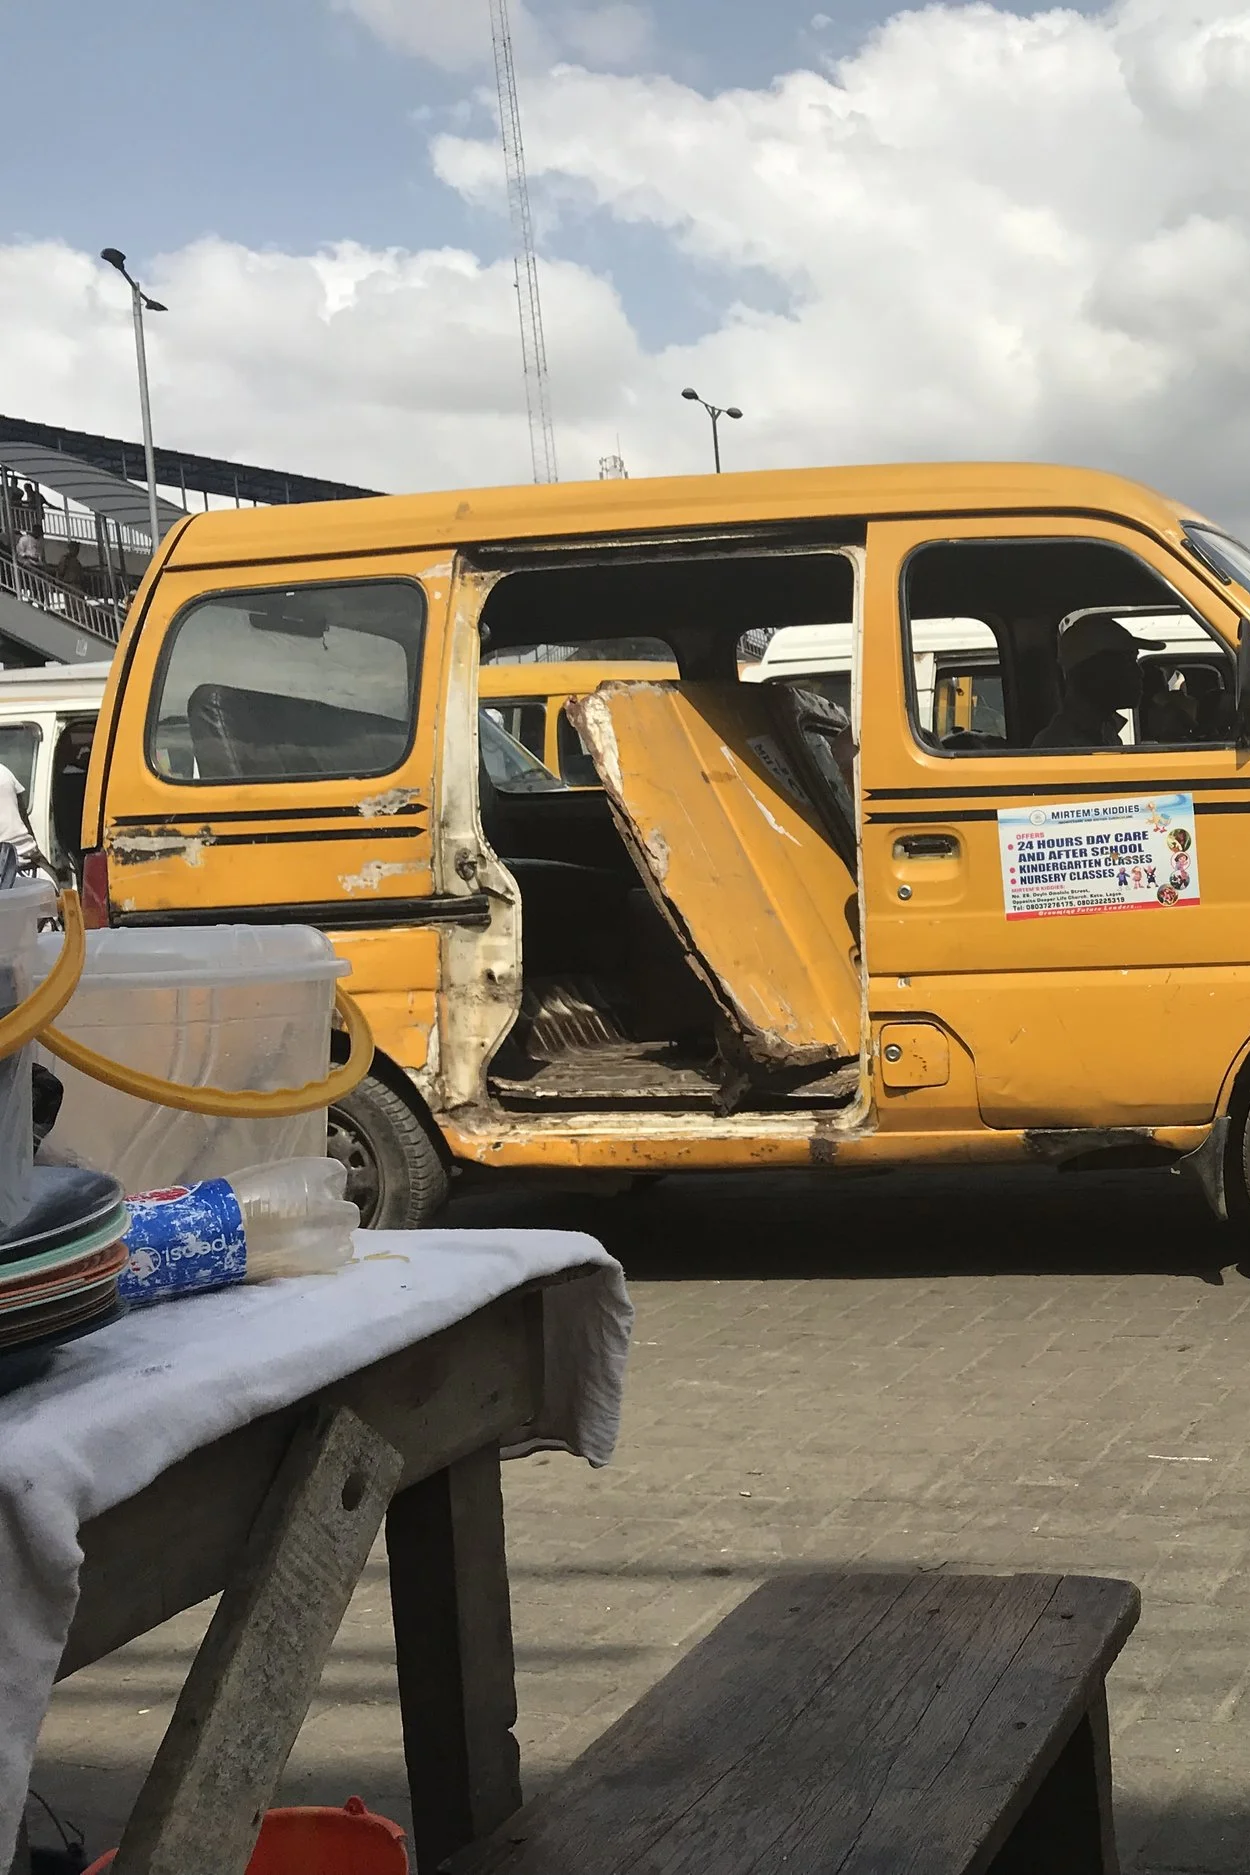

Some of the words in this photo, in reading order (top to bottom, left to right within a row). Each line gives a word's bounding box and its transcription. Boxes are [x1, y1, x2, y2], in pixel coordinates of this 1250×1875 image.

[1051, 807, 1100, 820] MIRTEM'S
[1103, 804, 1140, 816] KIDDIES
[1016, 832, 1045, 840] OFFERS
[1017, 840, 1034, 851] 24
[1037, 836, 1083, 849] HOURS
[1086, 834, 1111, 845] DAY
[1114, 831, 1149, 842] CARE
[1018, 852, 1045, 863] AND
[1048, 848, 1088, 860] AFTER
[1091, 843, 1144, 856] SCHOOL
[1019, 858, 1102, 874] KINDERGARTEN
[1104, 854, 1153, 867] CLASSES
[1020, 872, 1067, 885] NURSERY
[1069, 868, 1115, 881] CLASSES
